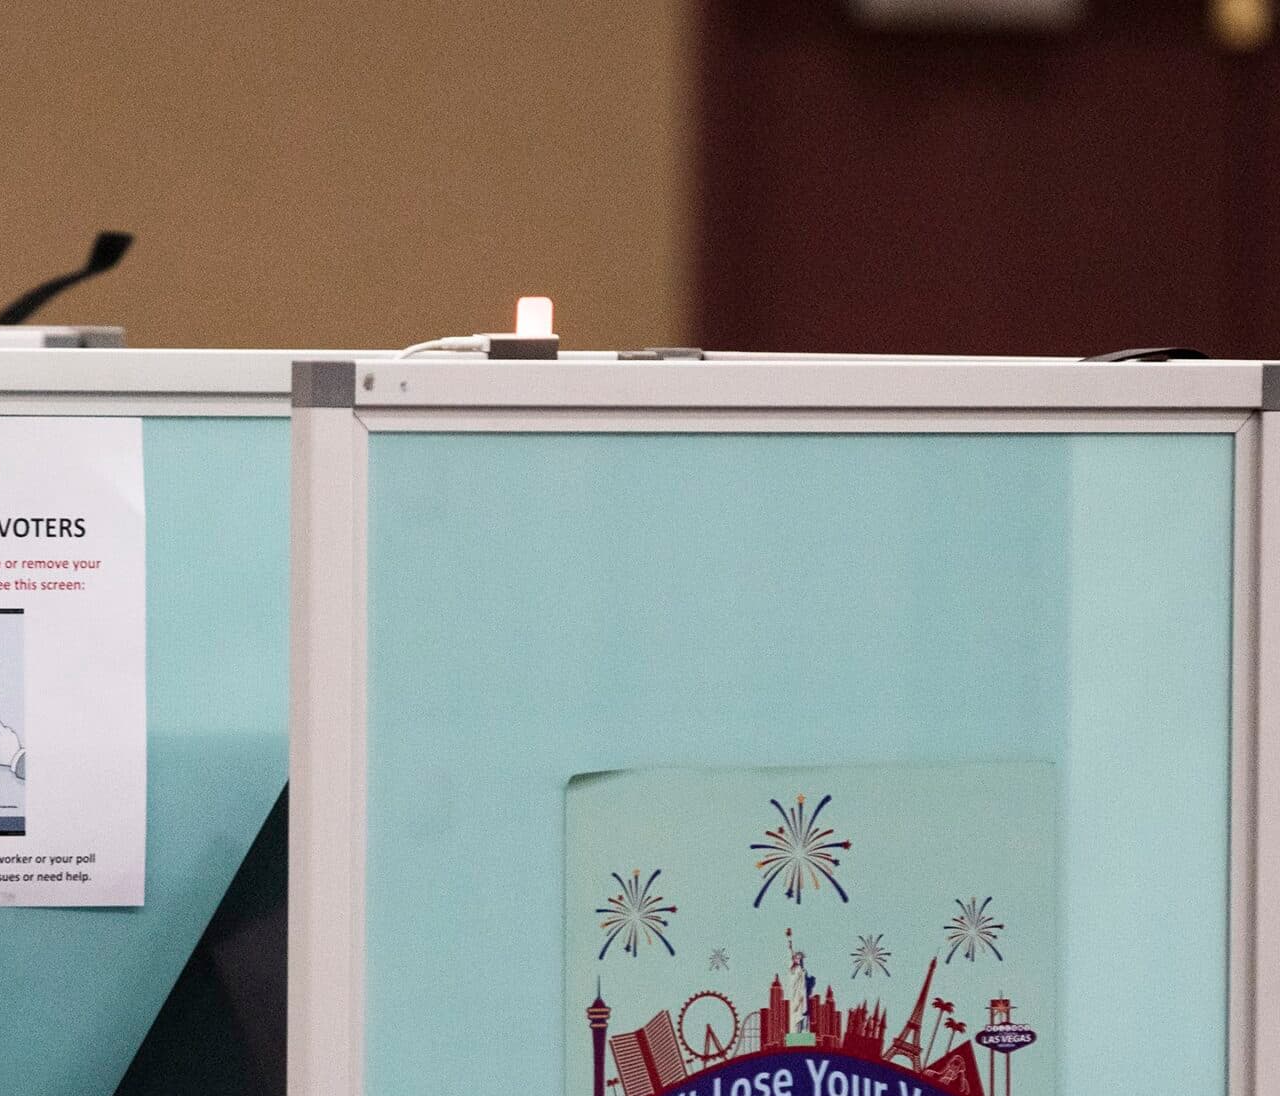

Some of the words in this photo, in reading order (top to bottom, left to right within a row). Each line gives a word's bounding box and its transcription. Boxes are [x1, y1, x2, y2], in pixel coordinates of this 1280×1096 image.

[5, 560, 18, 569] or
[22, 560, 69, 569] remove
[73, 560, 102, 572] your
[15, 578, 37, 590] this
[41, 580, 86, 590] screen:
[35, 855, 46, 864] or
[49, 855, 73, 866] your
[76, 853, 96, 866] poll
[23, 873, 34, 882] or
[37, 872, 63, 882] need
[66, 871, 92, 883] help.
[983, 1035, 1000, 1044] LAS
[1002, 1033, 1032, 1043] VEGAS
